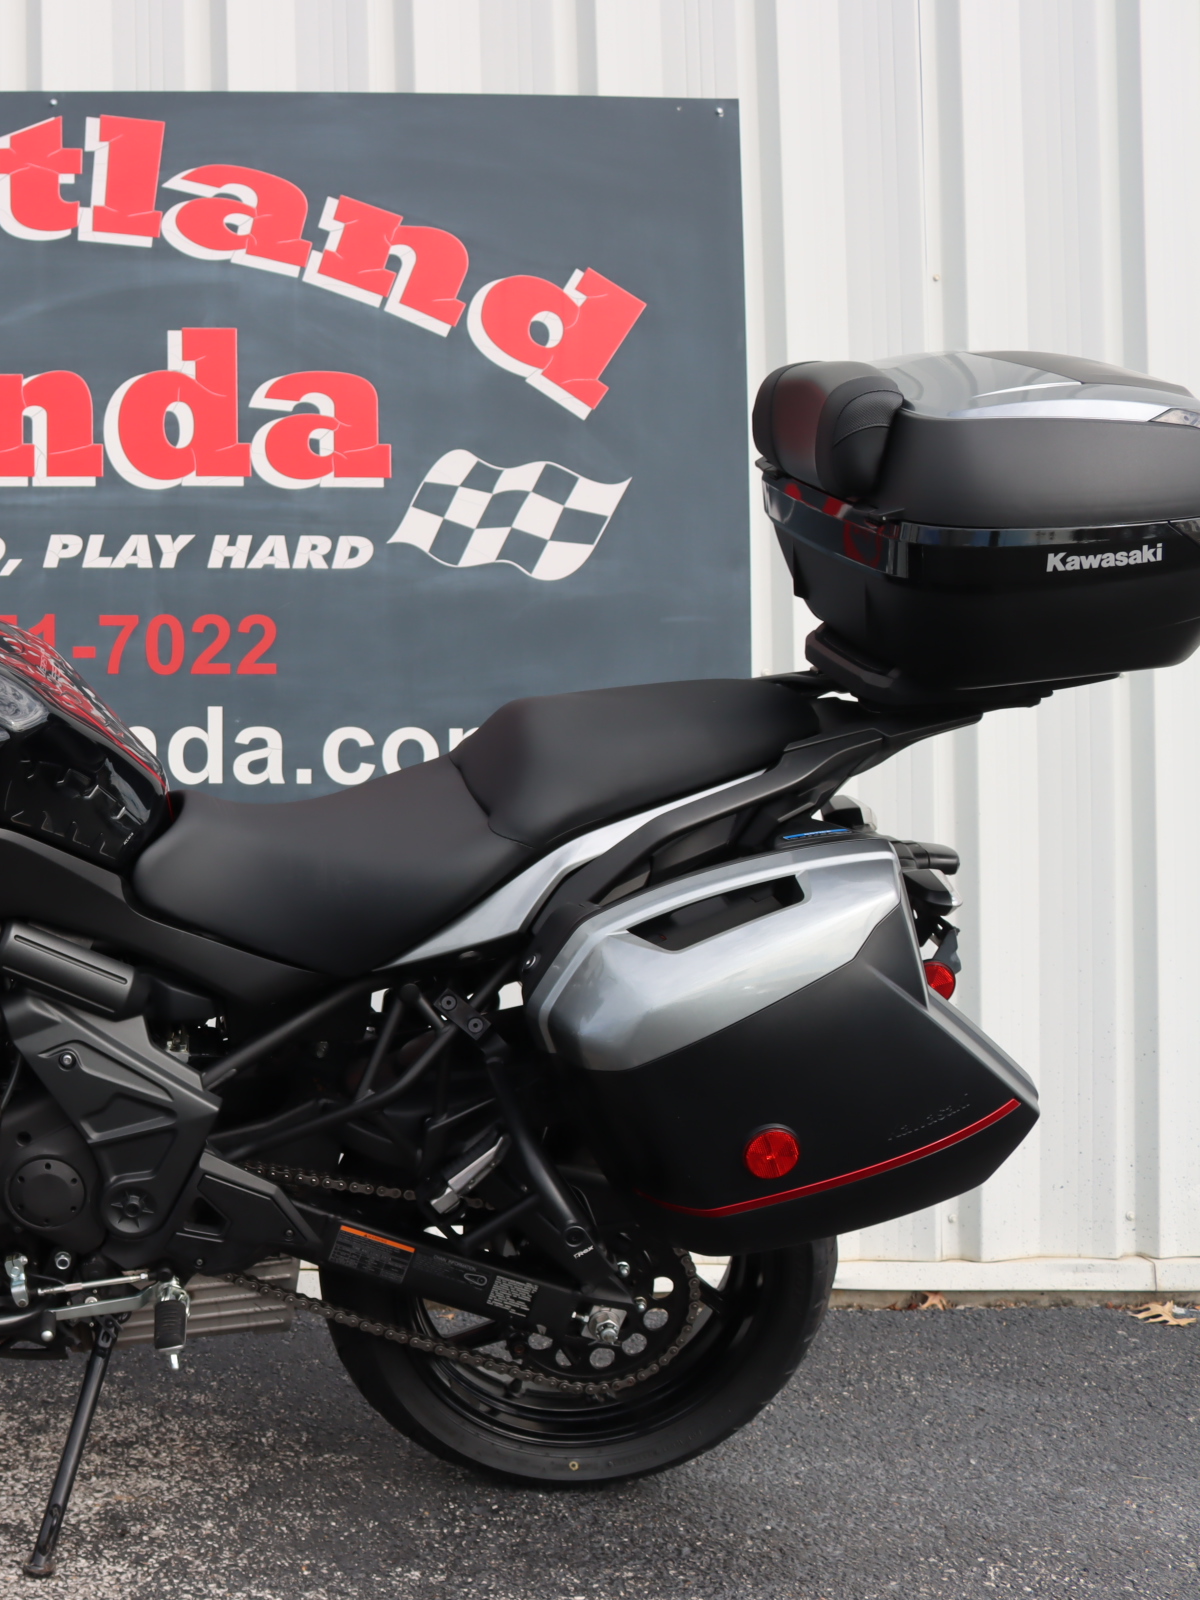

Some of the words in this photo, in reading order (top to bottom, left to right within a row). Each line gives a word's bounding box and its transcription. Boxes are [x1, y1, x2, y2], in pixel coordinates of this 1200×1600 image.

[43, 534, 196, 570] PLAY
[207, 534, 375, 570] HARD
[1046, 542, 1164, 573] Kawasaki
